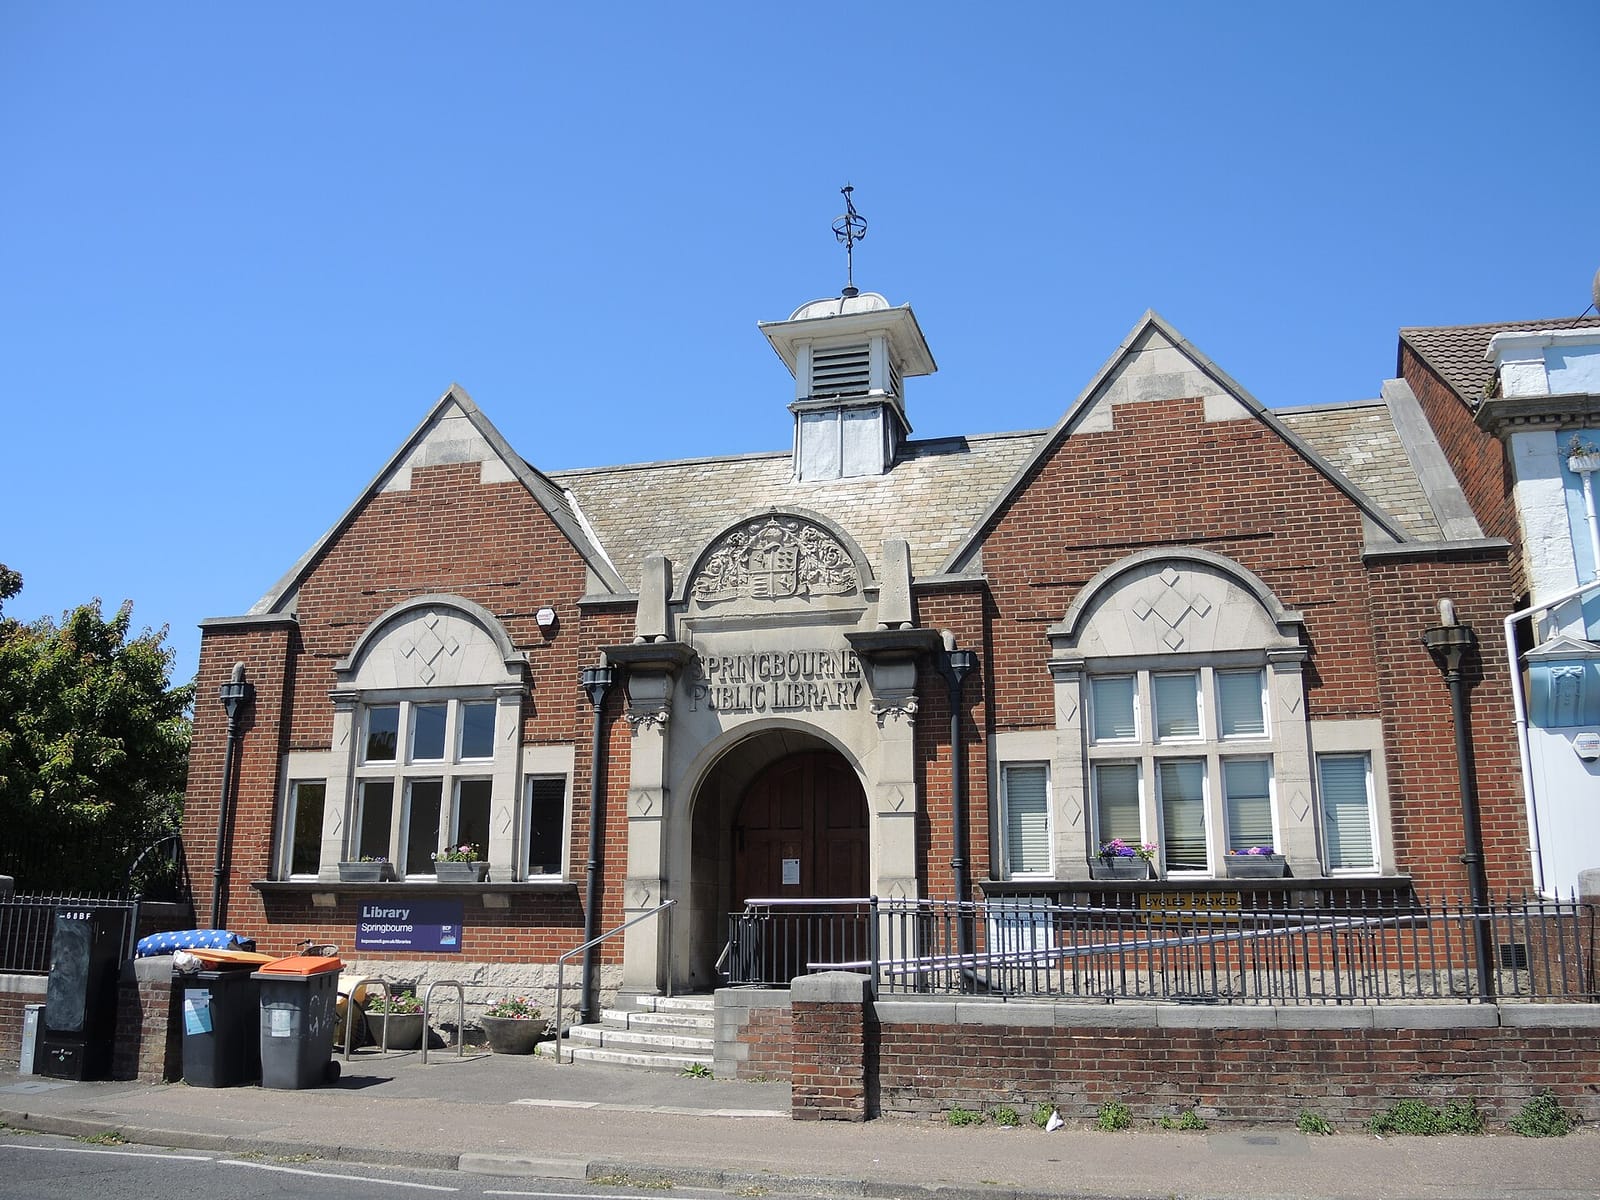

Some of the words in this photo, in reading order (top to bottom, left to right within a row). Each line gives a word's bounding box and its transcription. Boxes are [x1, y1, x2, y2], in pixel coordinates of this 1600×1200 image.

[689, 682, 766, 712] PUBLIC
[770, 680, 862, 710] LIBRARY
[362, 906, 410, 920] Library
[361, 923, 413, 933] Springbourne
